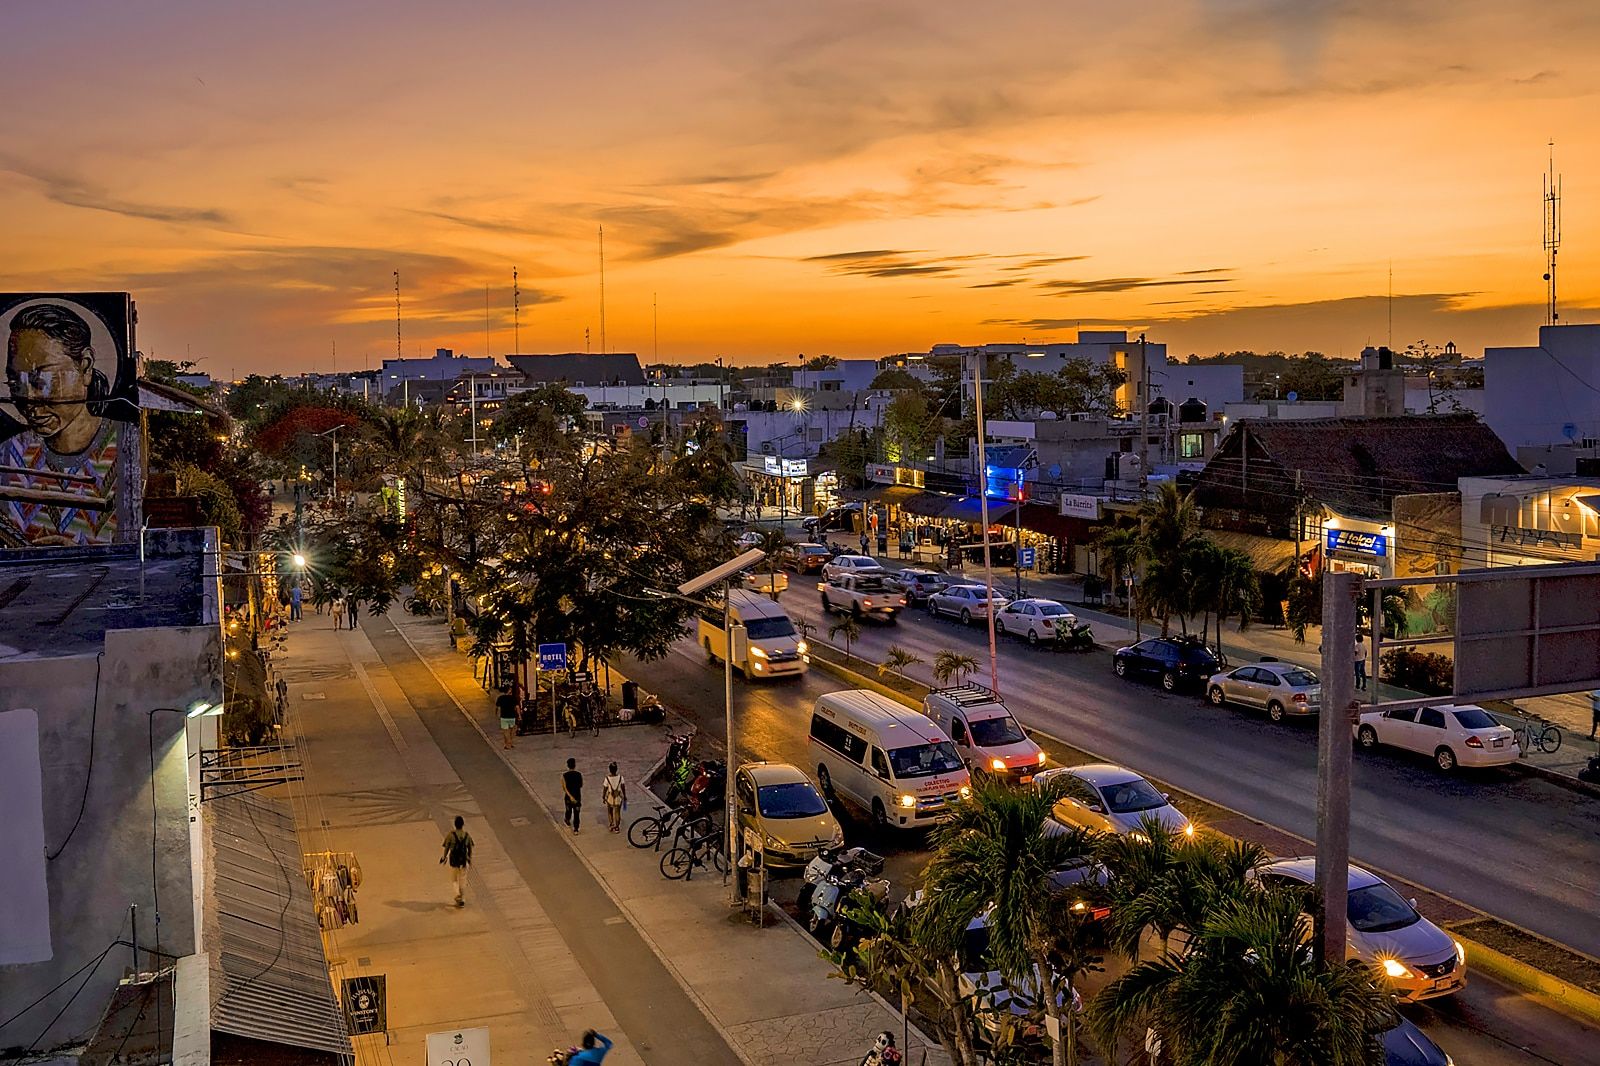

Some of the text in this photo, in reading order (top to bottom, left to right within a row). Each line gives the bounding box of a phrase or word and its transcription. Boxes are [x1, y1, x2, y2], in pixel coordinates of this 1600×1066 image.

[1347, 532, 1377, 548] telcel
[1023, 550, 1032, 564] E
[542, 653, 563, 661] HOTEL
[924, 778, 951, 787] COLECTIVO
